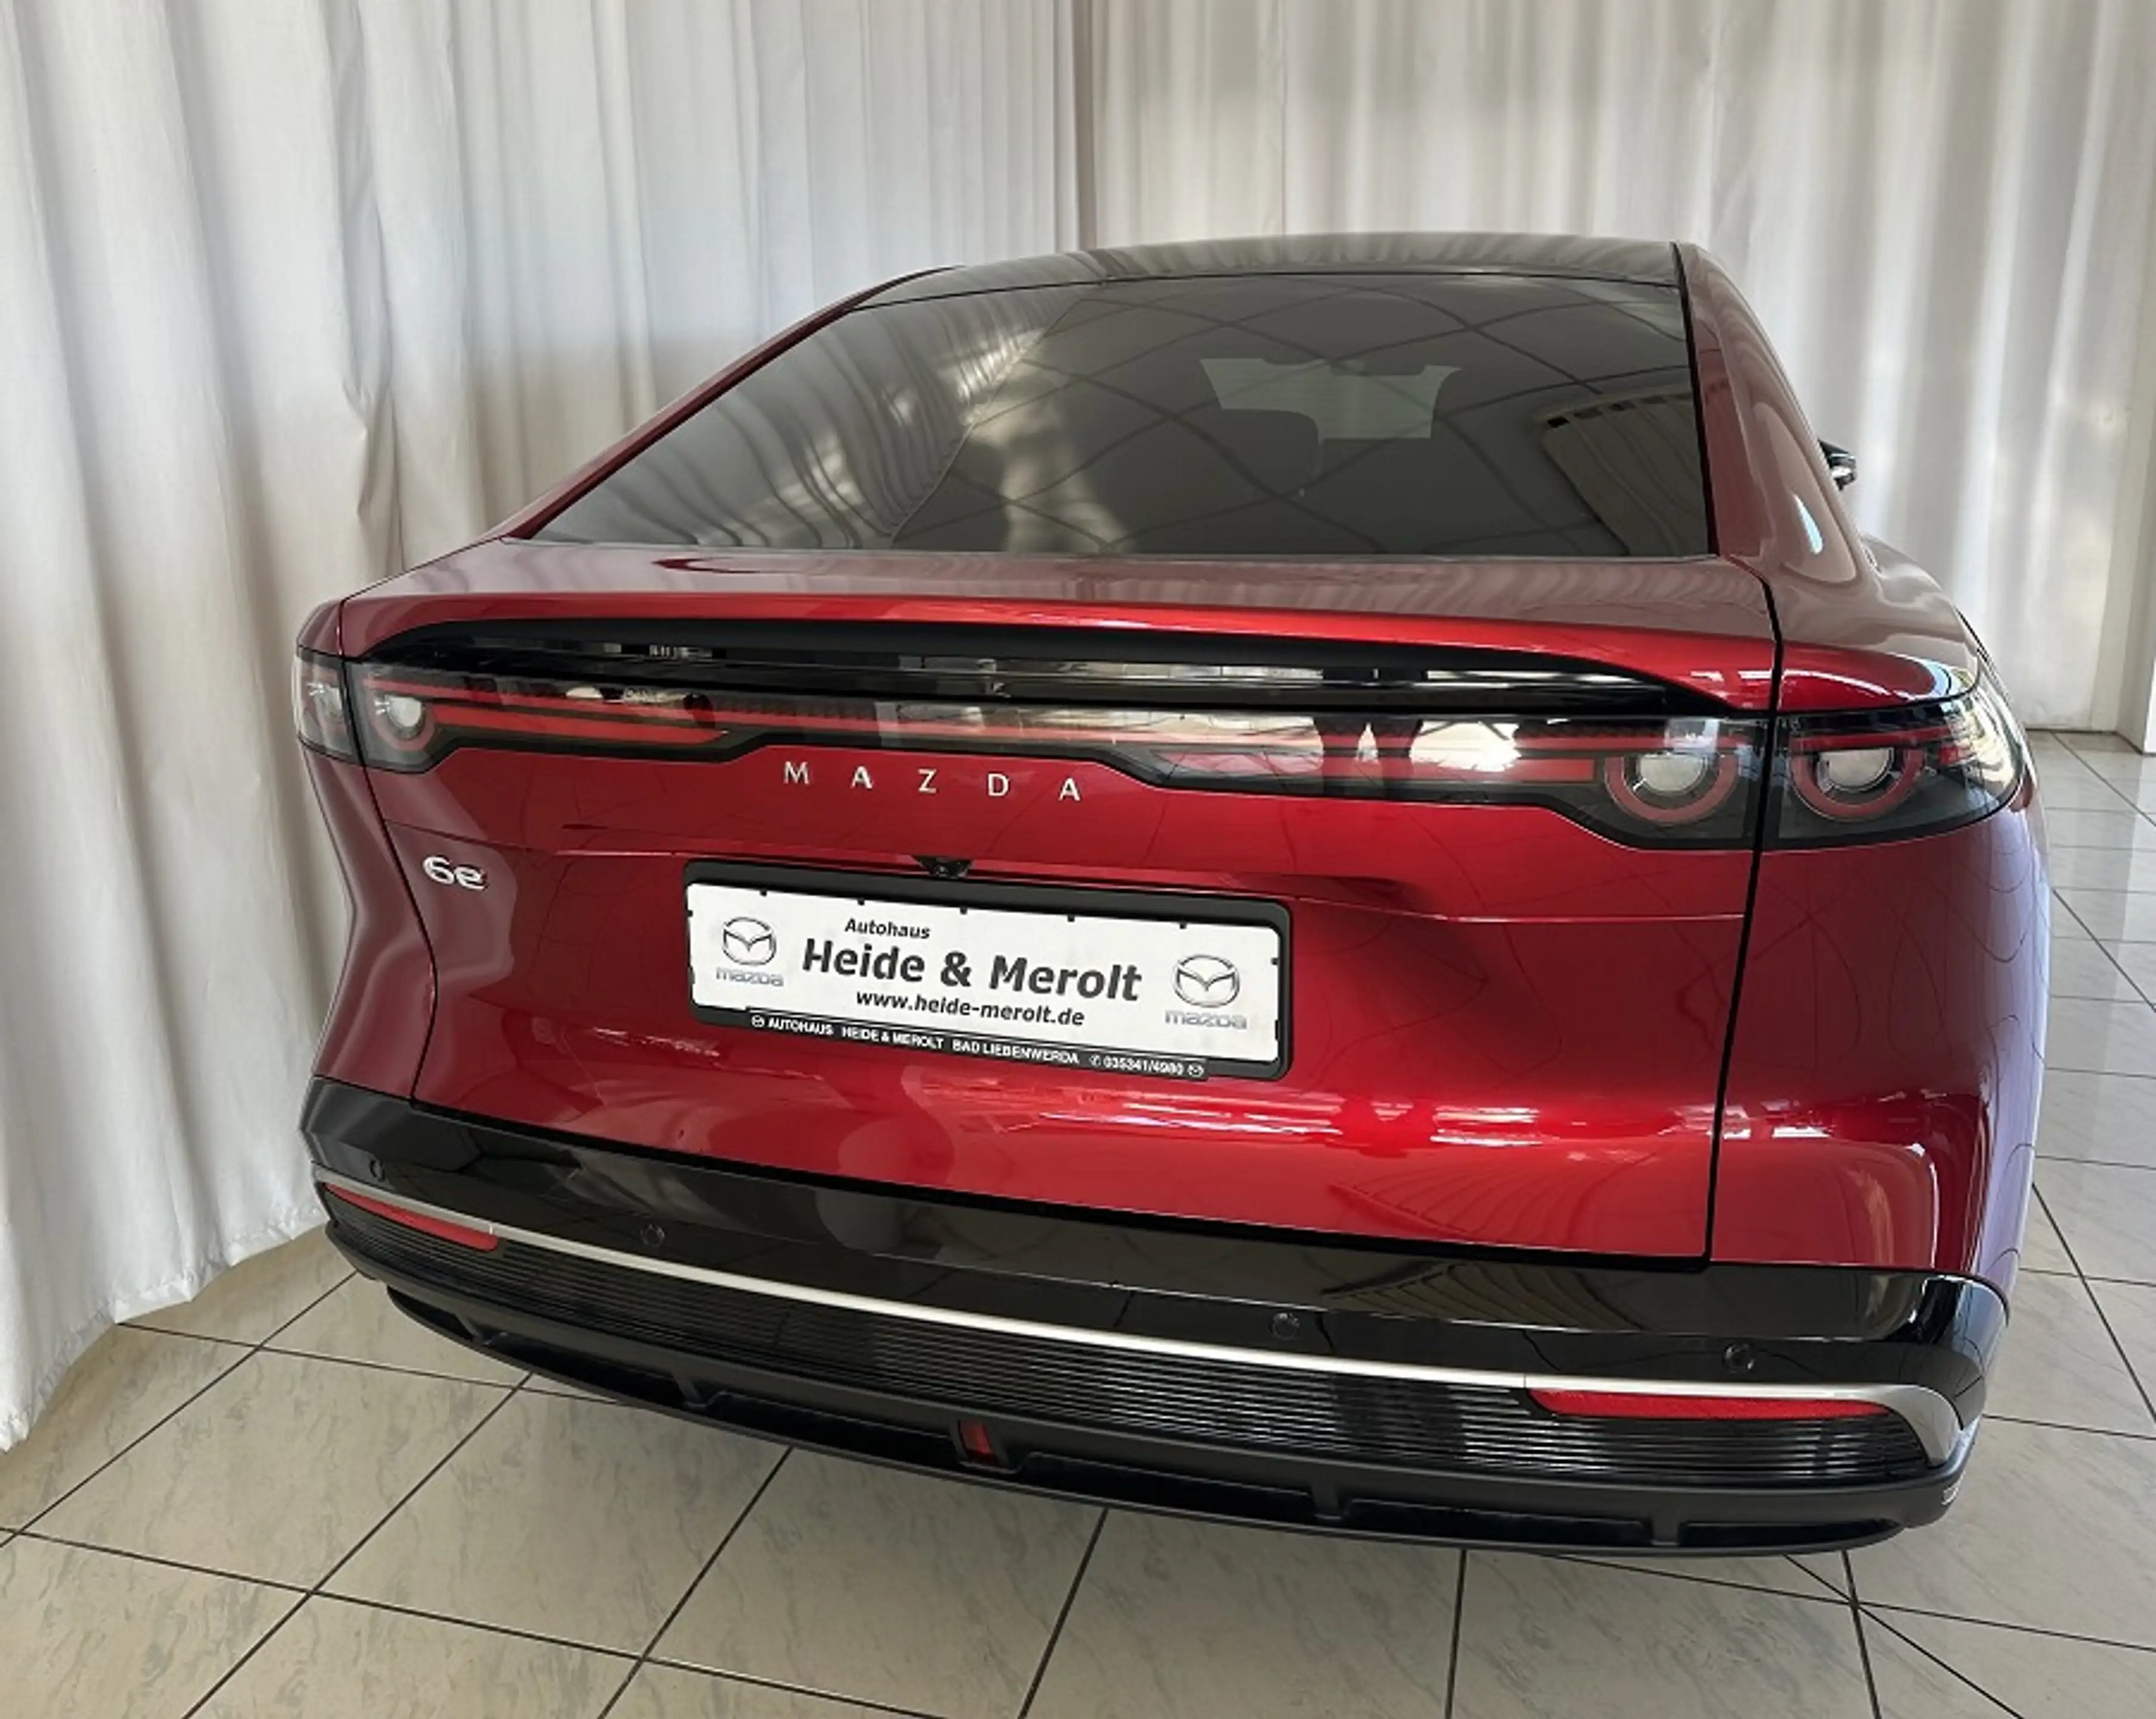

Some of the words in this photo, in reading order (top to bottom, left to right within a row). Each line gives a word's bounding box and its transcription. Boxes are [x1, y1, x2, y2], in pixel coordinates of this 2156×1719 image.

[783, 761, 1081, 801] MAZDA
[422, 856, 485, 890] 6e
[845, 918, 931, 939] Autohaus
[716, 967, 784, 987] mazda
[802, 938, 925, 982] Heide
[940, 951, 972, 987] &
[988, 954, 1142, 1002] Merolt
[856, 991, 1085, 1026] www.heide-merolt.de
[1165, 1009, 1248, 1030] mazda
[768, 1017, 834, 1036] AUTOHAUS
[842, 1027, 879, 1042] HEIDE
[880, 1030, 889, 1042] &
[892, 1032, 944, 1049] MEROLT
[952, 1039, 980, 1053] BAD
[983, 1043, 1080, 1064] LIEBENWERDA
